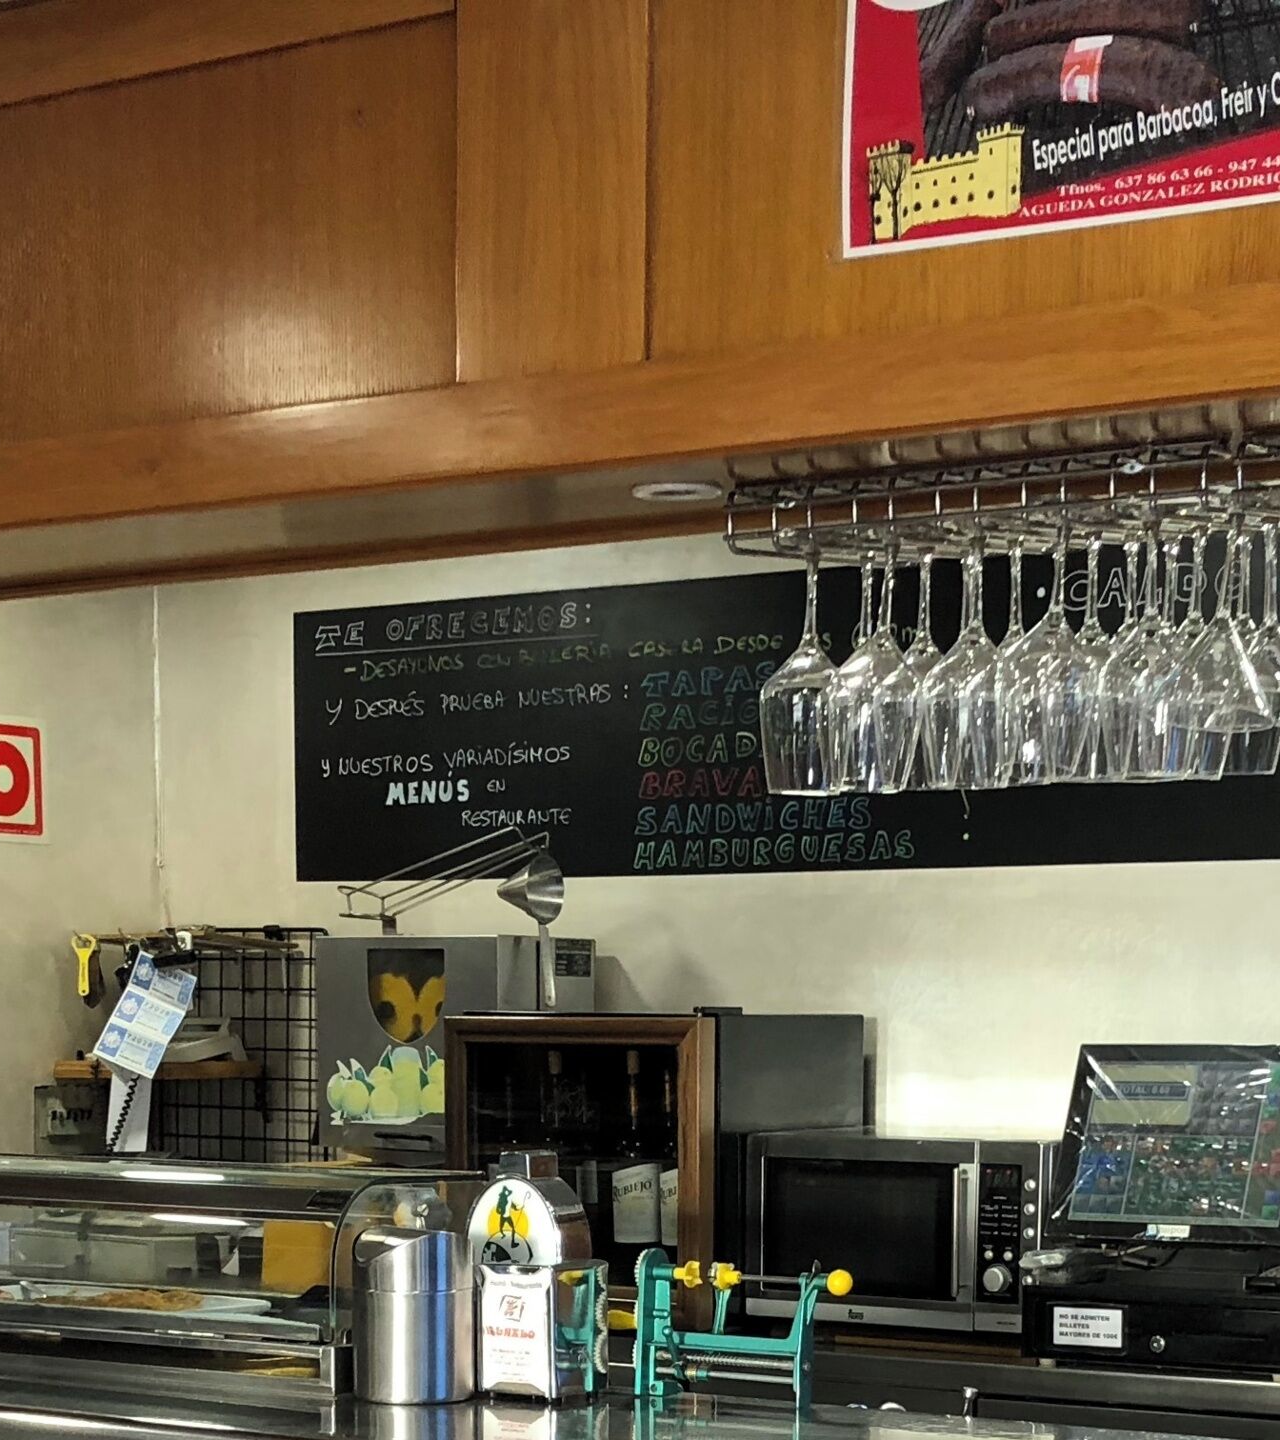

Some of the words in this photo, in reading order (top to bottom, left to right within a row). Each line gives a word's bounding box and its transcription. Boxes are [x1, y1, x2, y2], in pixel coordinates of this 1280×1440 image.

[1032, 126, 1094, 174] Especial
[1098, 119, 1135, 161] para
[1136, 100, 1218, 141] Barbacoa,
[1221, 81, 1254, 119] Freir
[1257, 83, 1269, 117] y
[1114, 173, 1142, 190] 637
[1147, 170, 1166, 185] 86
[1170, 168, 1190, 182] 63
[1193, 165, 1213, 179] 66
[1228, 157, 1257, 174] 947
[1018, 197, 1094, 218] AGUEDA
[1099, 182, 1206, 208] GONZALEZ
[315, 620, 365, 652] TE
[627, 638, 704, 658] CASRA
[713, 633, 784, 655] DESDE
[640, 660, 776, 698] TAPAS
[355, 691, 425, 721] DESPUÉS
[440, 690, 505, 716] PRUEBA
[518, 683, 612, 709] NUESTRAS
[338, 753, 435, 777] NUESTROS
[638, 765, 764, 800] BRAVA
[385, 770, 470, 806] MENÚS
[487, 779, 506, 792] EN
[461, 807, 573, 828] RESTAURANTE
[632, 829, 915, 871] HAMBURGUESAS
[612, 1181, 653, 1204] RUBIEJO
